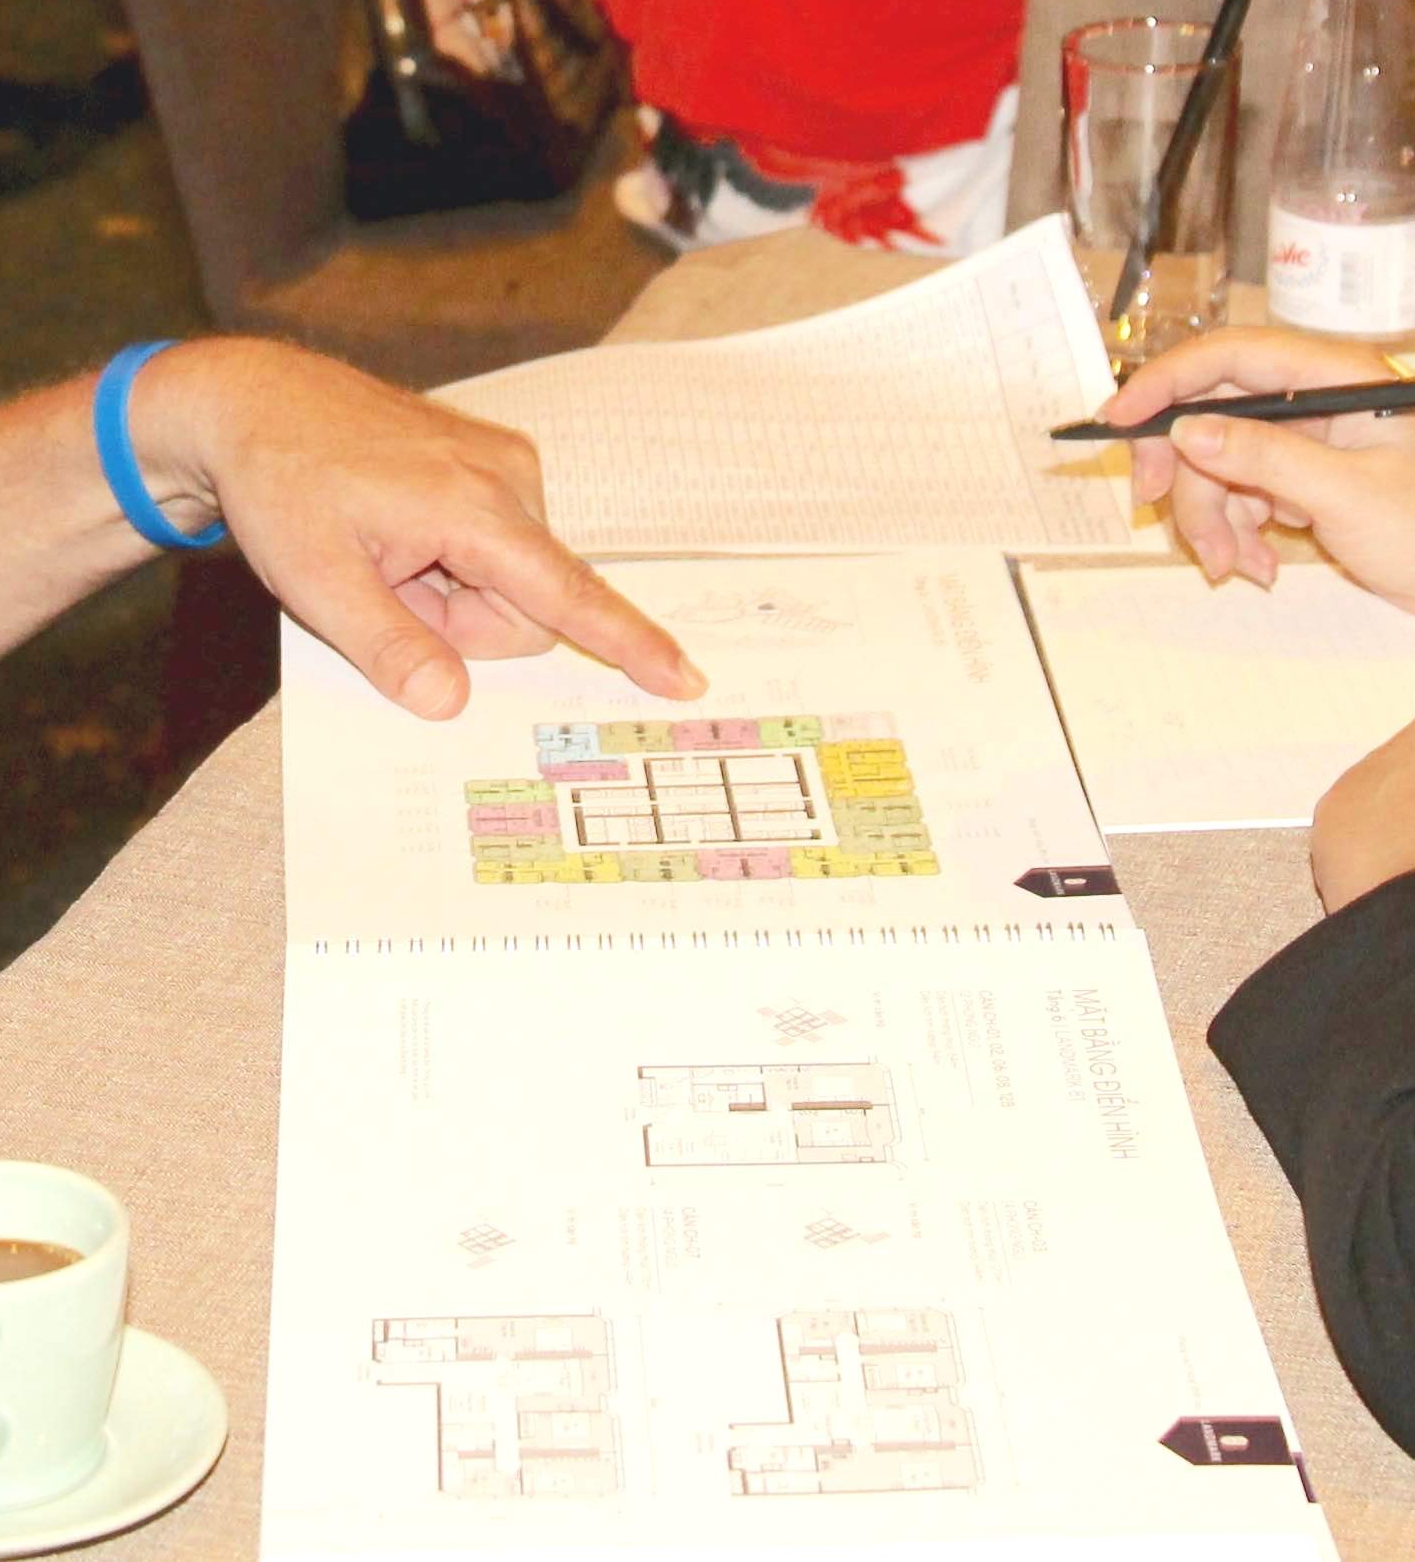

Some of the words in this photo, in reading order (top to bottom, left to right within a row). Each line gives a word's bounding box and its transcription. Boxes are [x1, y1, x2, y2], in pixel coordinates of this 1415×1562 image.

[1070, 989, 1108, 1023] MẶT
[1055, 1030, 1085, 1087] LANDMARK
[1080, 1028, 1122, 1077] BẰNG
[1067, 1090, 1086, 1103] 81
[1092, 1080, 1139, 1117] ĐIỂN
[1101, 1121, 1140, 1160] HÌNH
[1201, 1419, 1222, 1462] LANDMARK
